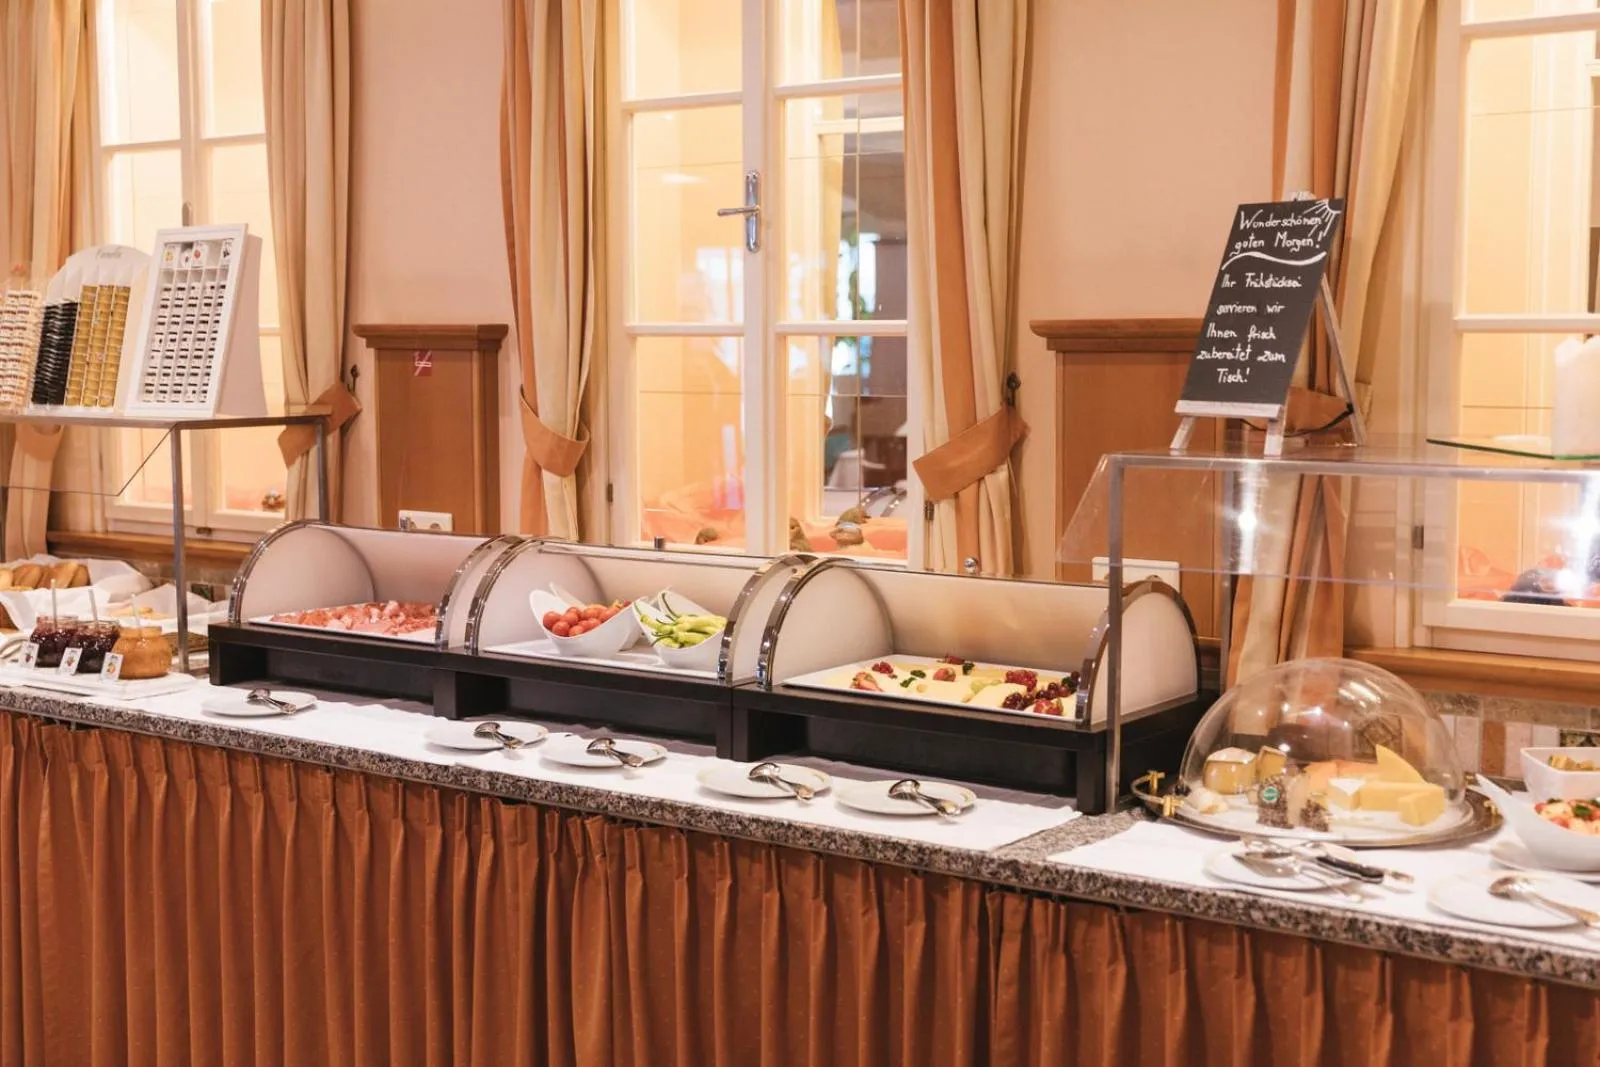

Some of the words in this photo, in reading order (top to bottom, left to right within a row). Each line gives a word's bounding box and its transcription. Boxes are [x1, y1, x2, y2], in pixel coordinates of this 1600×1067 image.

[1239, 209, 1322, 231] Wonderschönen
[1230, 233, 1265, 256] guten
[1274, 231, 1323, 252] Morgen!
[1221, 273, 1237, 289] Ihr
[1216, 302, 1257, 315] servieren
[1266, 302, 1286, 314] wir
[1206, 322, 1238, 339] Ihnen
[1247, 324, 1277, 342] frisch
[1196, 343, 1252, 362] zubereitet
[1256, 350, 1286, 363] zum
[1216, 367, 1250, 383] Tisch!
